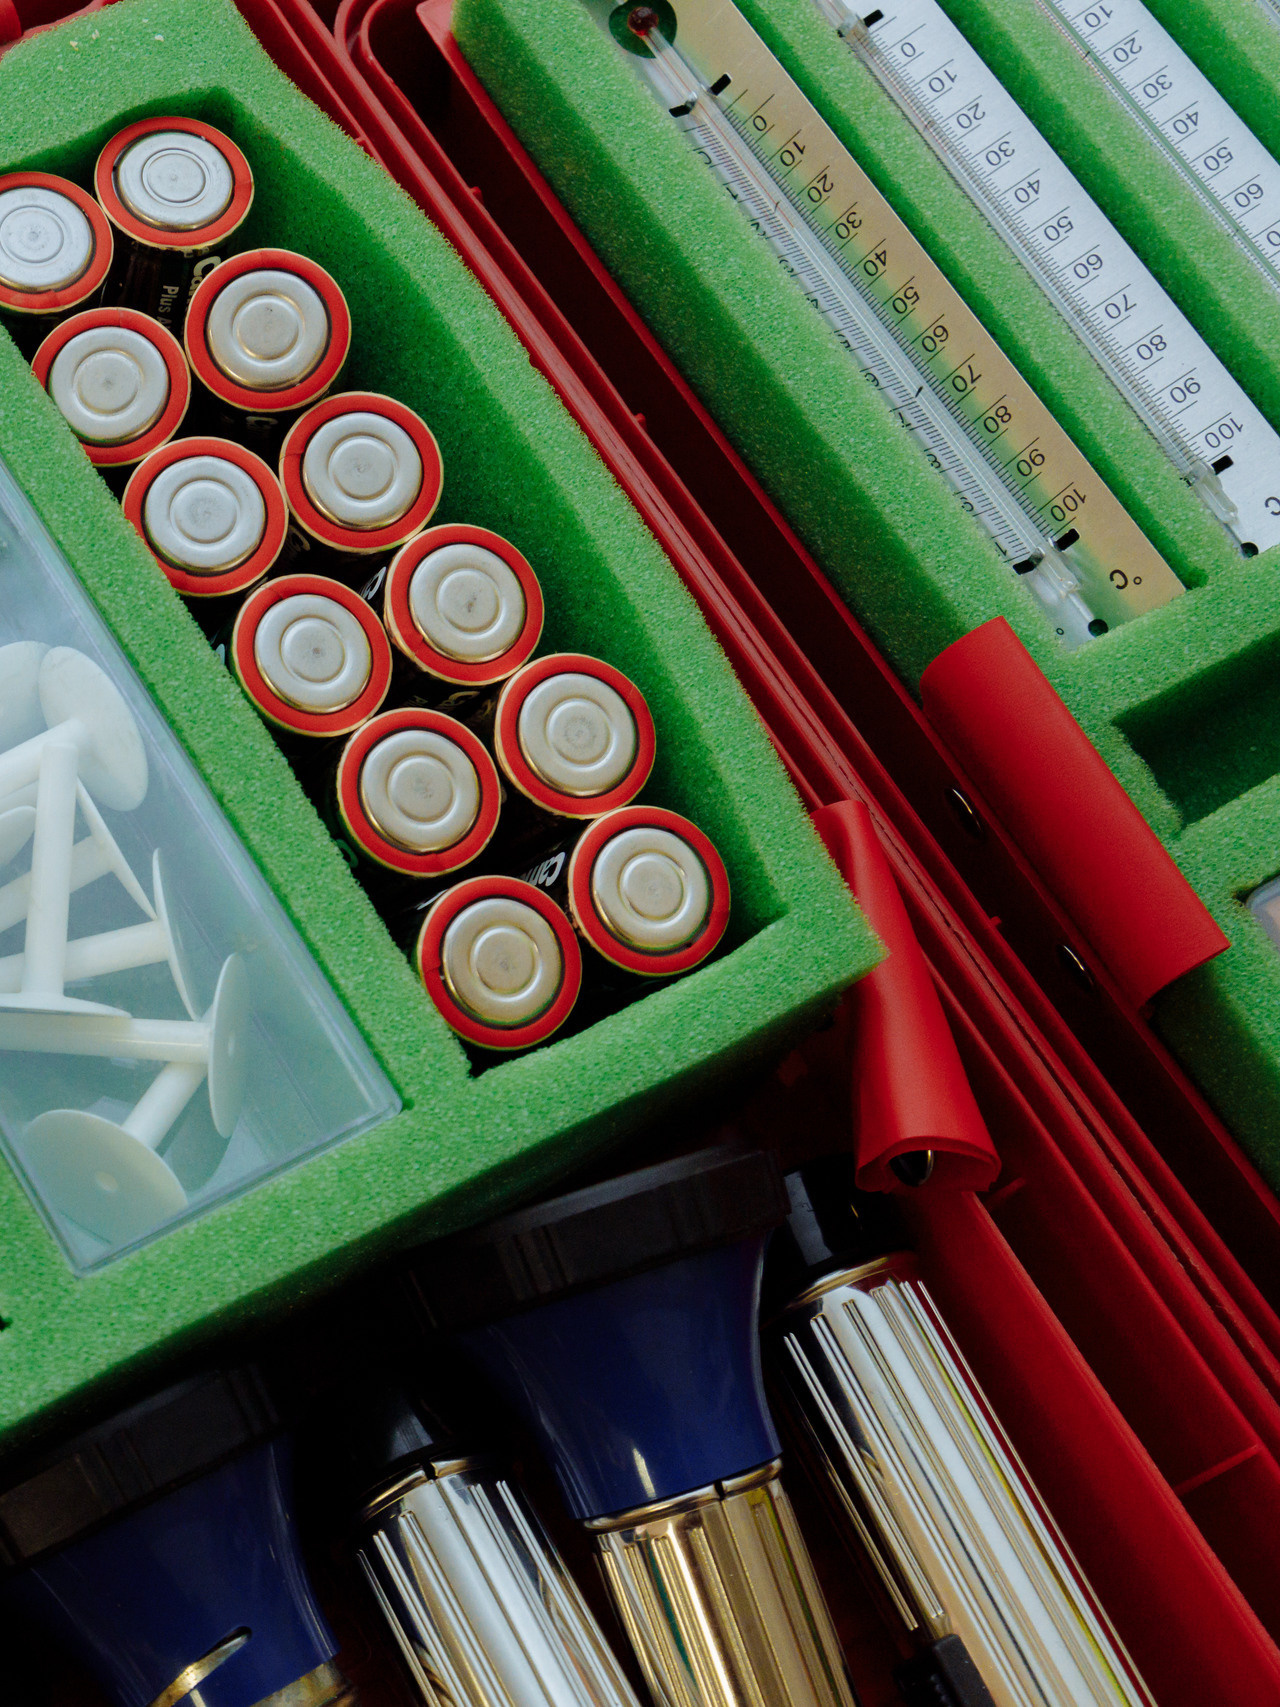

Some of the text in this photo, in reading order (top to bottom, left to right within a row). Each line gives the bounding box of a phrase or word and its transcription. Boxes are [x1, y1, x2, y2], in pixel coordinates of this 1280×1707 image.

[1084, 6, 1113, 28] 10
[900, 42, 916, 58] 0
[1114, 38, 1142, 63] 20
[928, 70, 958, 93] 10
[1143, 74, 1173, 99] 30
[752, 115, 767, 131] 0
[956, 102, 986, 129] 20
[1173, 112, 1199, 135] 40
[780, 140, 806, 167] 10
[986, 141, 1015, 166] 30
[1204, 146, 1234, 172] 50
[807, 174, 834, 203] 20
[1014, 180, 1040, 203] 40
[1234, 184, 1264, 208] 60
[835, 212, 862, 240] 30
[1044, 216, 1074, 241] 50
[1267, 231, 1280, 246] 0
[863, 250, 887, 277] 40
[1074, 254, 1103, 279] 60
[158, 285, 180, 314] Plus
[892, 286, 920, 314] 50
[1104, 294, 1137, 320] 70
[922, 325, 949, 353] 60
[1136, 335, 1167, 360] 80
[952, 365, 982, 393] 70
[1170, 378, 1201, 403] 90
[983, 406, 1012, 434] 80
[1204, 418, 1244, 448] 100
[1016, 448, 1045, 477] 90
[1050, 488, 1087, 522] 100
